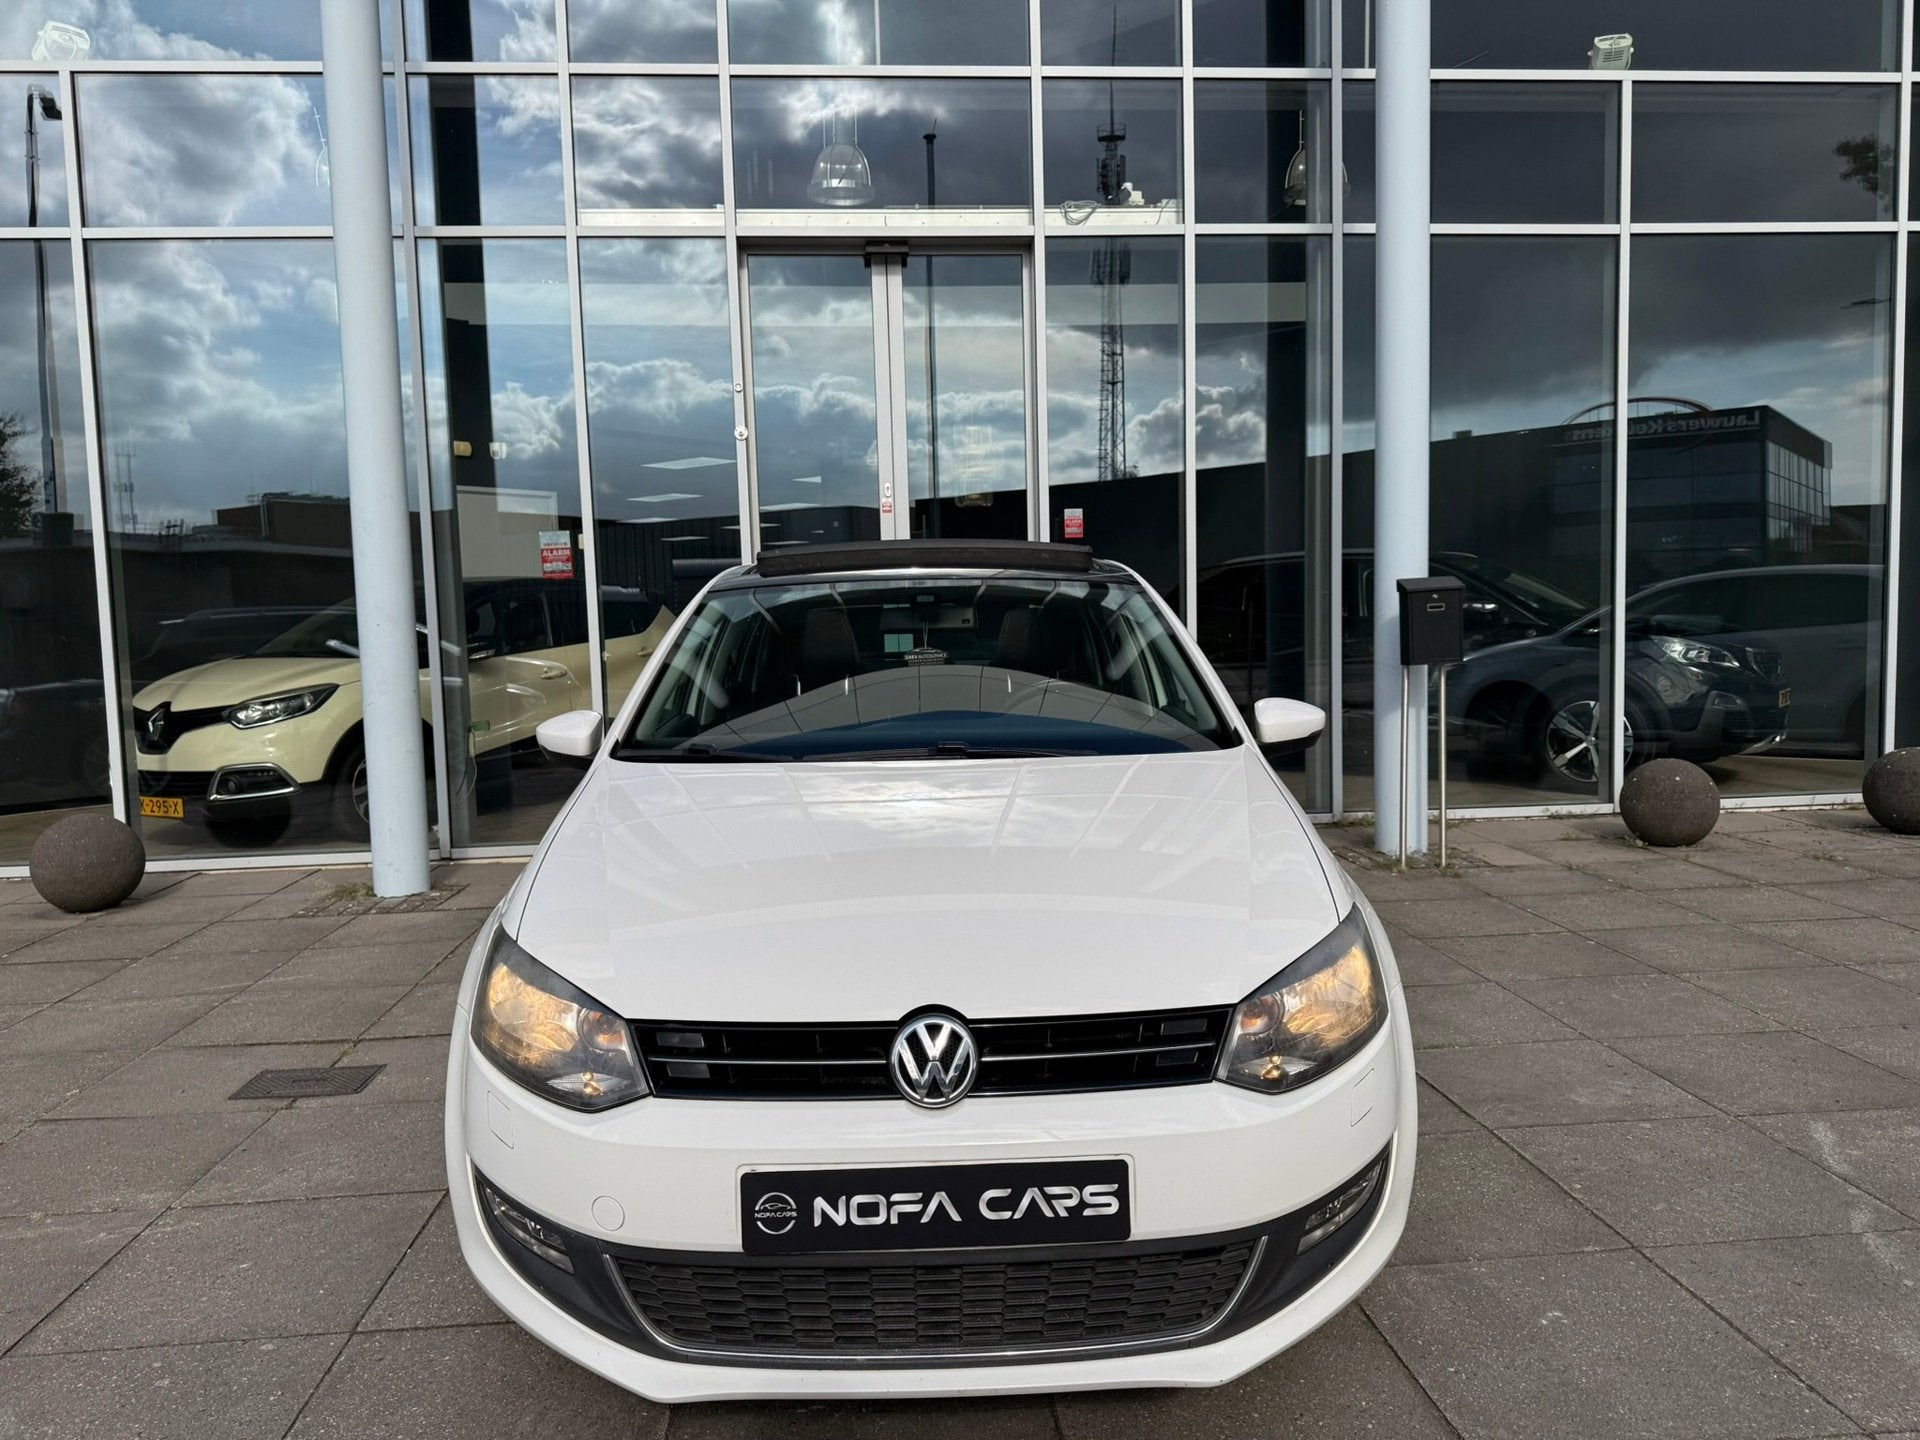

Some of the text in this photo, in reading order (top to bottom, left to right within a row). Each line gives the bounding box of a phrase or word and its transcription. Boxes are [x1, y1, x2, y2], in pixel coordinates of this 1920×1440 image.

[542, 549, 570, 557] ALARM
[813, 1183, 1120, 1228] NOFA CARS
